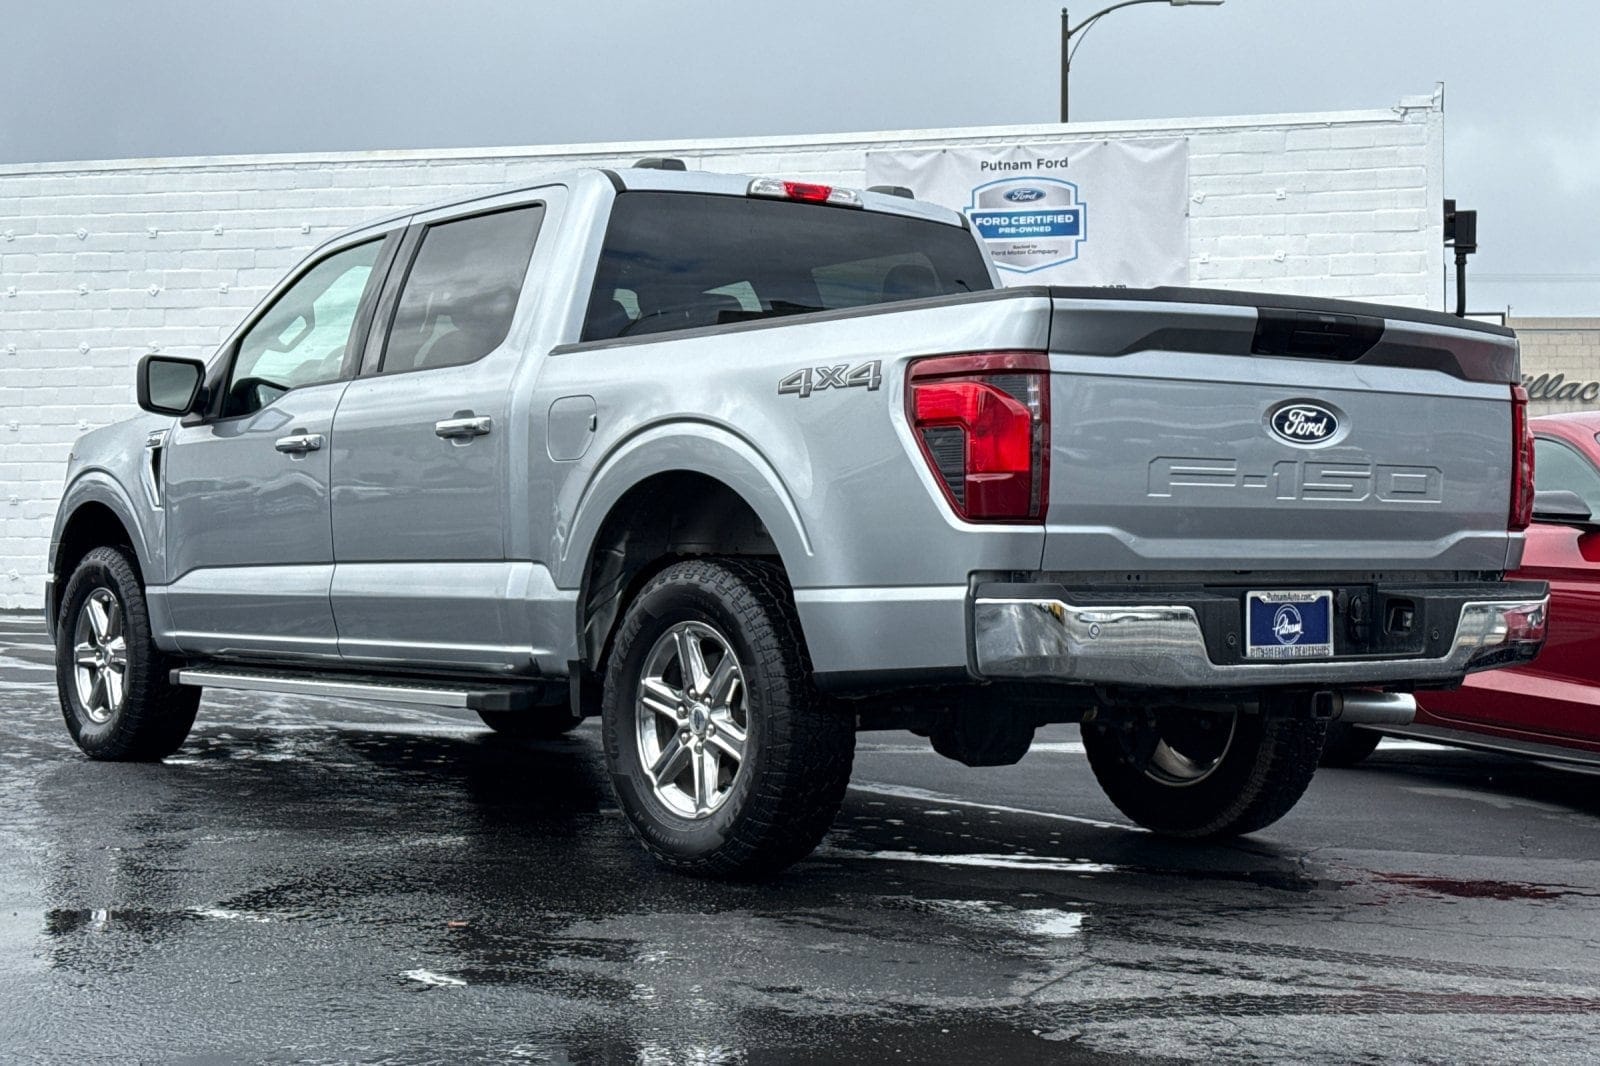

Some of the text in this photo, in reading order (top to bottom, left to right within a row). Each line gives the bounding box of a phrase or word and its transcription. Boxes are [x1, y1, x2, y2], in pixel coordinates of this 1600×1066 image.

[980, 157, 1068, 171] Putnam Ford
[1011, 189, 1038, 201] Ford
[975, 214, 1074, 227] FORD CERTIFIED
[998, 225, 1052, 234] PRE-OWNED
[1521, 373, 1600, 403] illac
[1283, 407, 1328, 437] Ford
[1147, 455, 1444, 504] F-150
